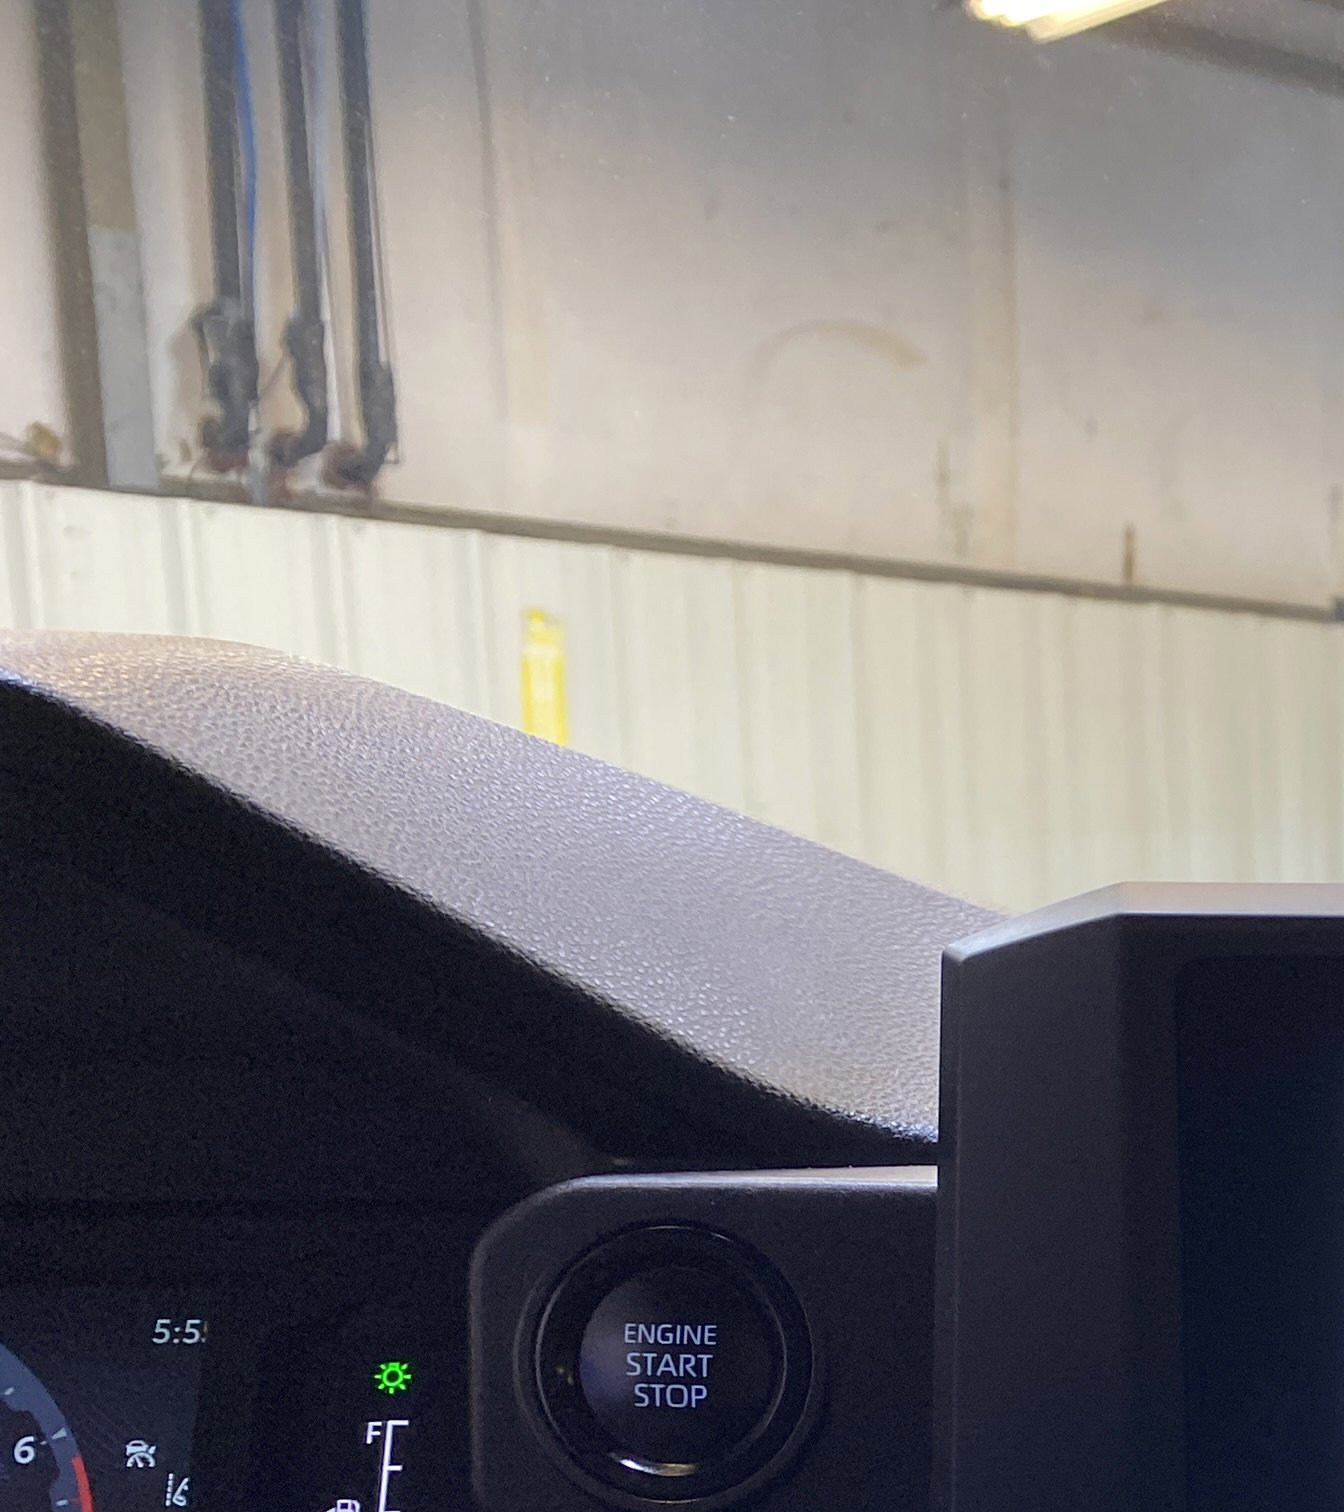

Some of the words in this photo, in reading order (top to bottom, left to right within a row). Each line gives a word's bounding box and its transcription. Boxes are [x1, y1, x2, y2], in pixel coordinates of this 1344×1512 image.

[623, 1323, 717, 1346] ENGINE
[625, 1353, 713, 1377] START
[634, 1383, 708, 1409] STOP
[366, 1421, 383, 1445] F
[13, 1435, 35, 1464] 6
